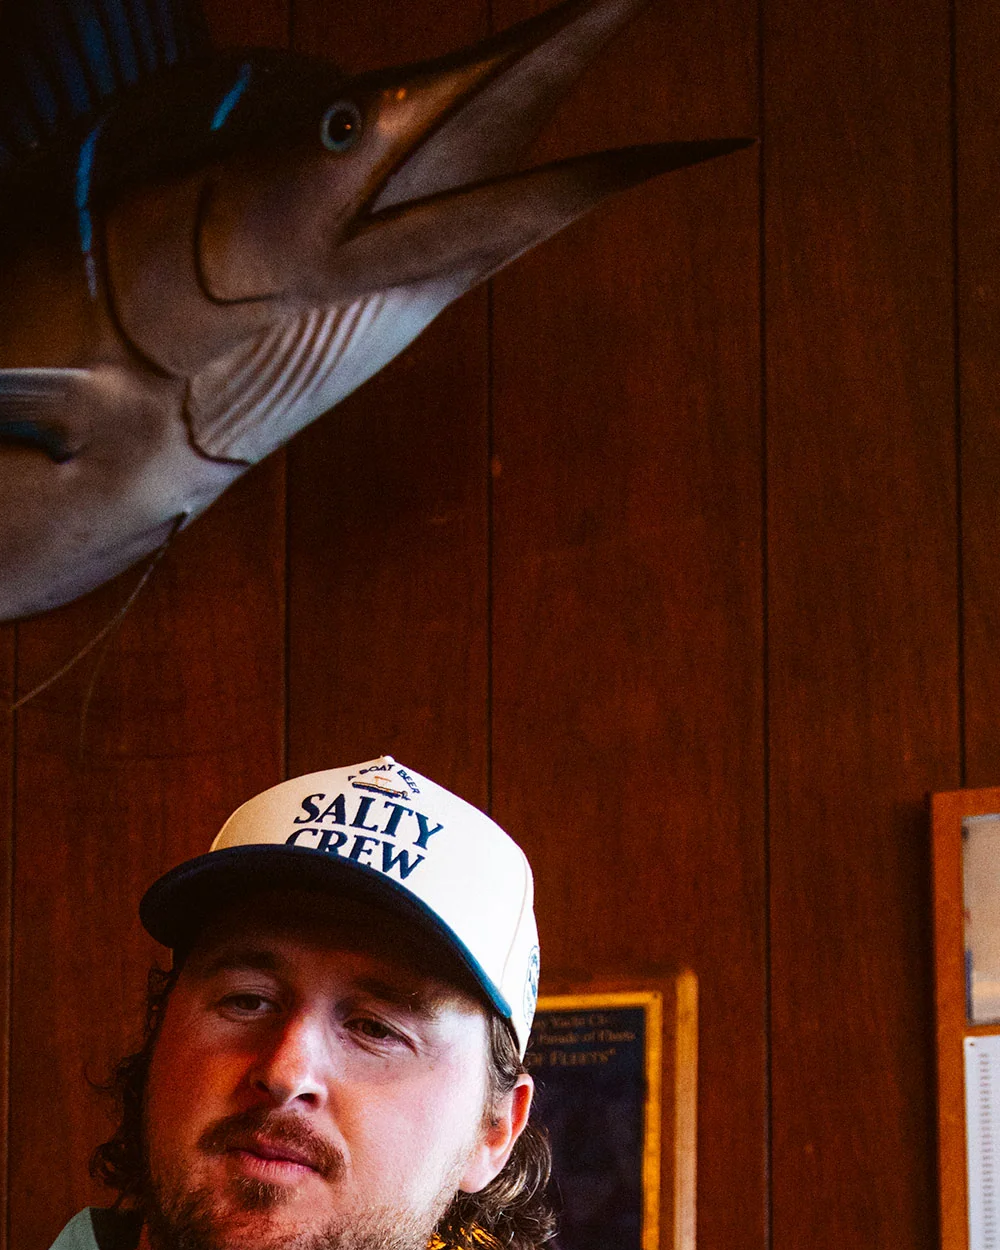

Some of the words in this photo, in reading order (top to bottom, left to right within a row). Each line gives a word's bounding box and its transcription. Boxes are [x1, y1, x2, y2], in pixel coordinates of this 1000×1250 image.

[359, 764, 395, 775] BOAT
[397, 769, 420, 794] BEER
[293, 793, 444, 850] SALTY
[284, 828, 426, 880] CREW
